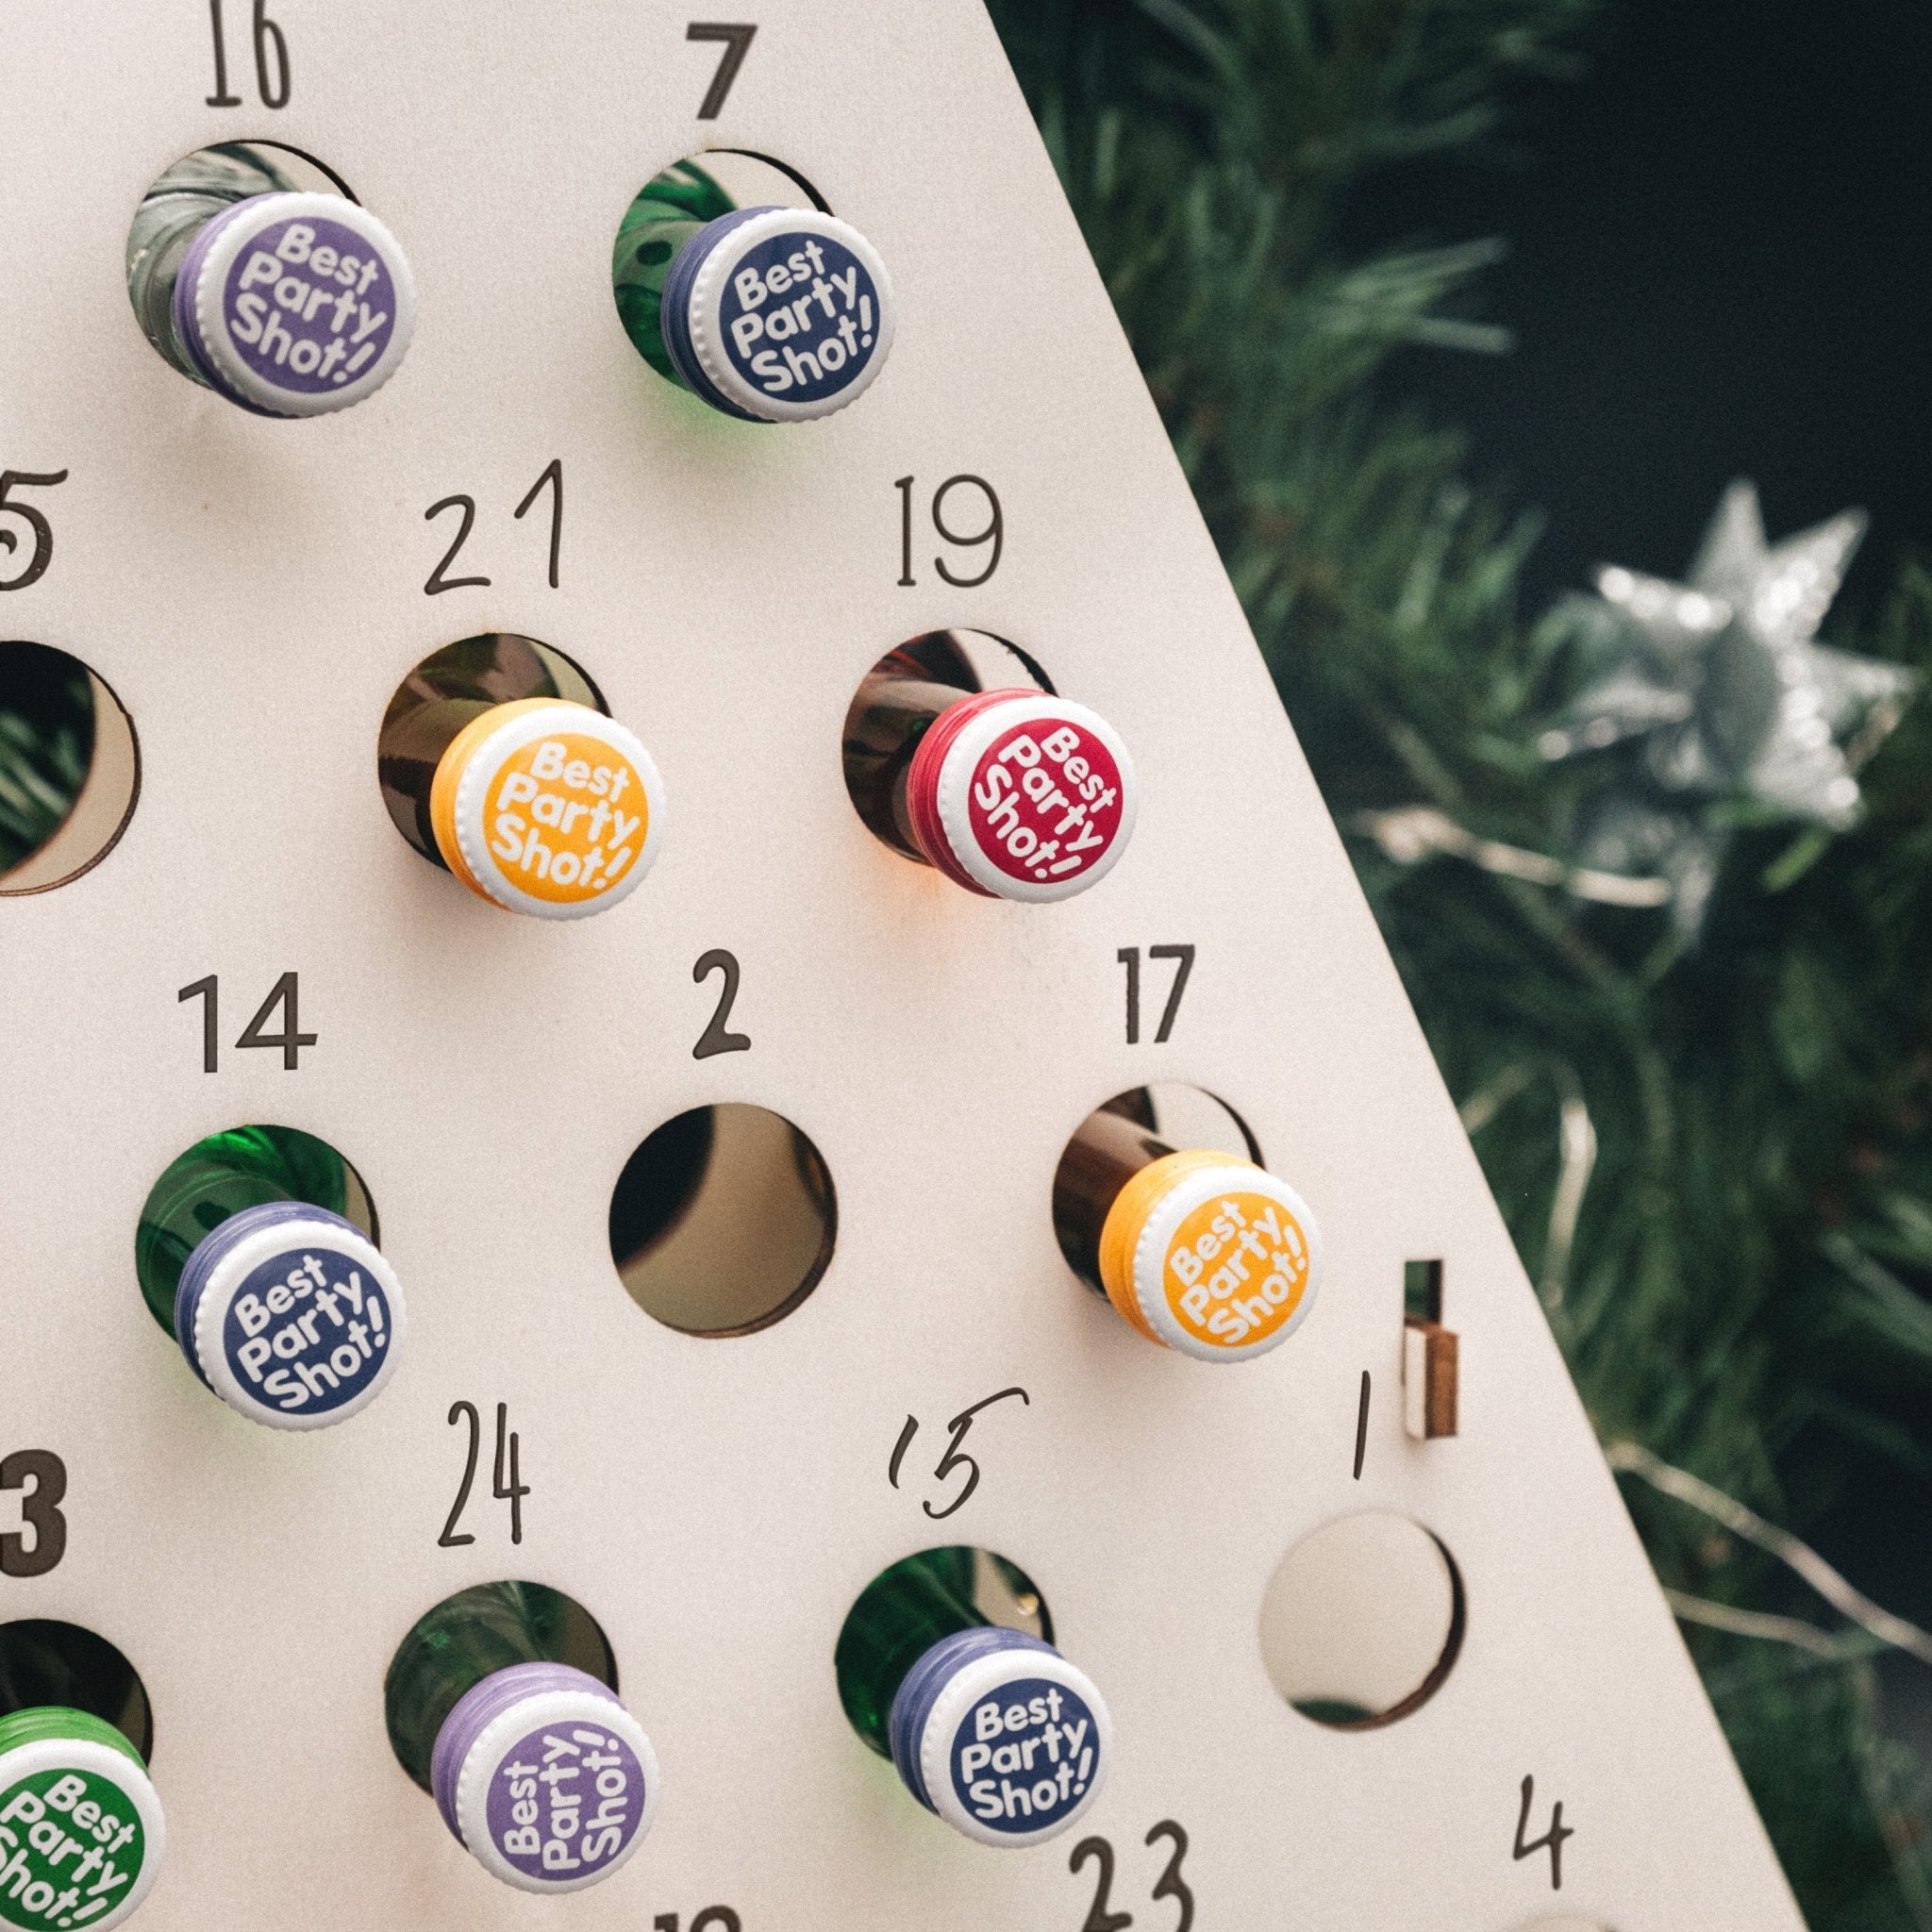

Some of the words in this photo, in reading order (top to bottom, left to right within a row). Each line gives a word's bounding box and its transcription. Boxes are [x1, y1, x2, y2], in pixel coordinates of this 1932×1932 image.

[206, 0, 291, 109] 16
[686, 23, 758, 121] 7
[239, 251, 387, 344] Party
[275, 224, 378, 295] Best
[735, 241, 824, 311] Best
[231, 295, 375, 383] Shot!
[730, 267, 857, 359] Party
[751, 295, 872, 391] Shot!
[424, 459, 563, 596] 21
[894, 474, 1004, 589] 19
[496, 773, 641, 847] Party
[530, 741, 630, 803] Best
[1000, 735, 1104, 852] Party
[1041, 726, 1116, 812] Best
[491, 818, 631, 889] Shot!
[974, 764, 1082, 878] Shot!
[177, 971, 319, 1074] 14
[691, 948, 752, 1060] 2
[1117, 944, 1195, 1045] 17
[1169, 1200, 1245, 1285] Best
[1180, 1207, 1280, 1327] Party
[1208, 1224, 1307, 1343] Shot!
[234, 1255, 325, 1335] Best
[238, 1271, 364, 1382] Party
[264, 1314, 387, 1408] Shot!
[437, 1400, 531, 1548] 24
[888, 1387, 1030, 1520] 15
[1353, 1370, 1372, 1481] 1
[0, 1448, 68, 1578] 3
[960, 1719, 1088, 1782] Party
[974, 1688, 1063, 1741] Best
[43, 1774, 135, 1854] Best
[503, 1759, 540, 1855] Best
[543, 1735, 580, 1872] Party
[573, 1729, 628, 1864] Shot!
[970, 1747, 1092, 1819] Shot!
[1512, 1774, 1575, 1890] 4
[0, 1790, 128, 1896] Party
